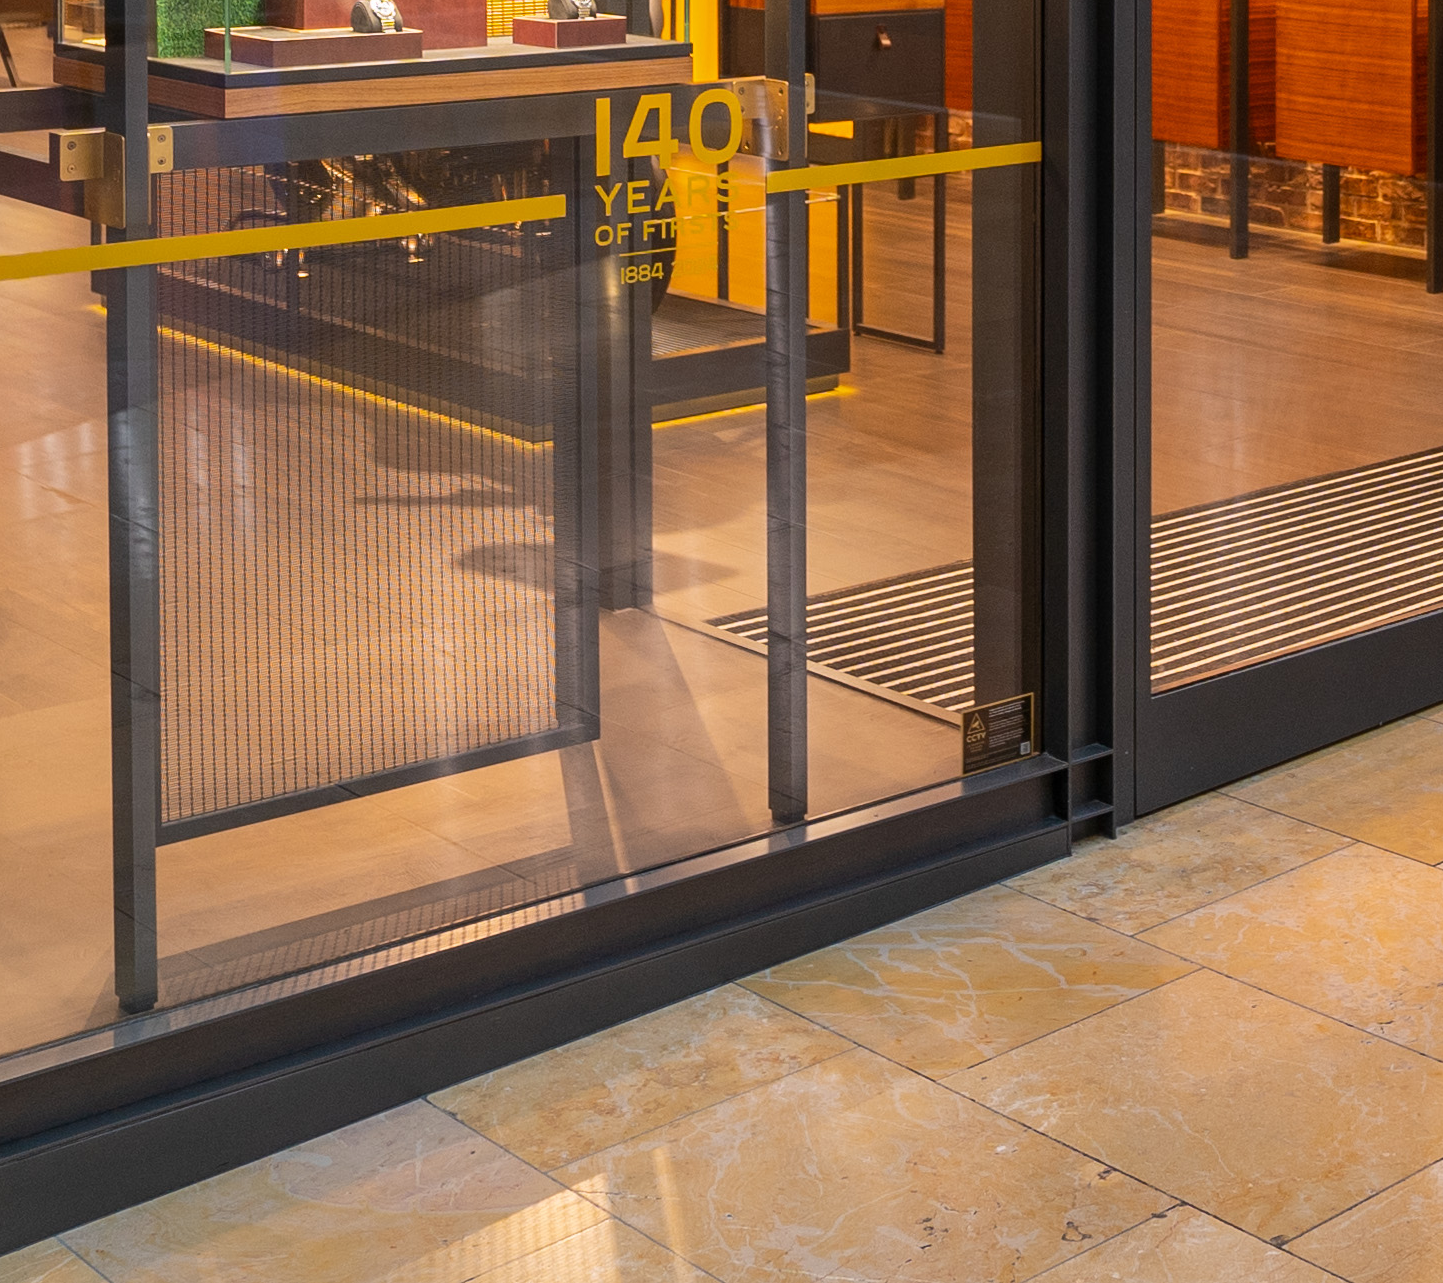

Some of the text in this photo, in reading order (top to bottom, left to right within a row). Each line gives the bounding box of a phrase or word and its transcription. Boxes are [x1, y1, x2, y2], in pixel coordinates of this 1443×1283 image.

[596, 88, 743, 177] 140
[594, 171, 739, 217] YEARS
[594, 211, 738, 247] OF FIRSTS
[966, 731, 987, 743] CCTV
